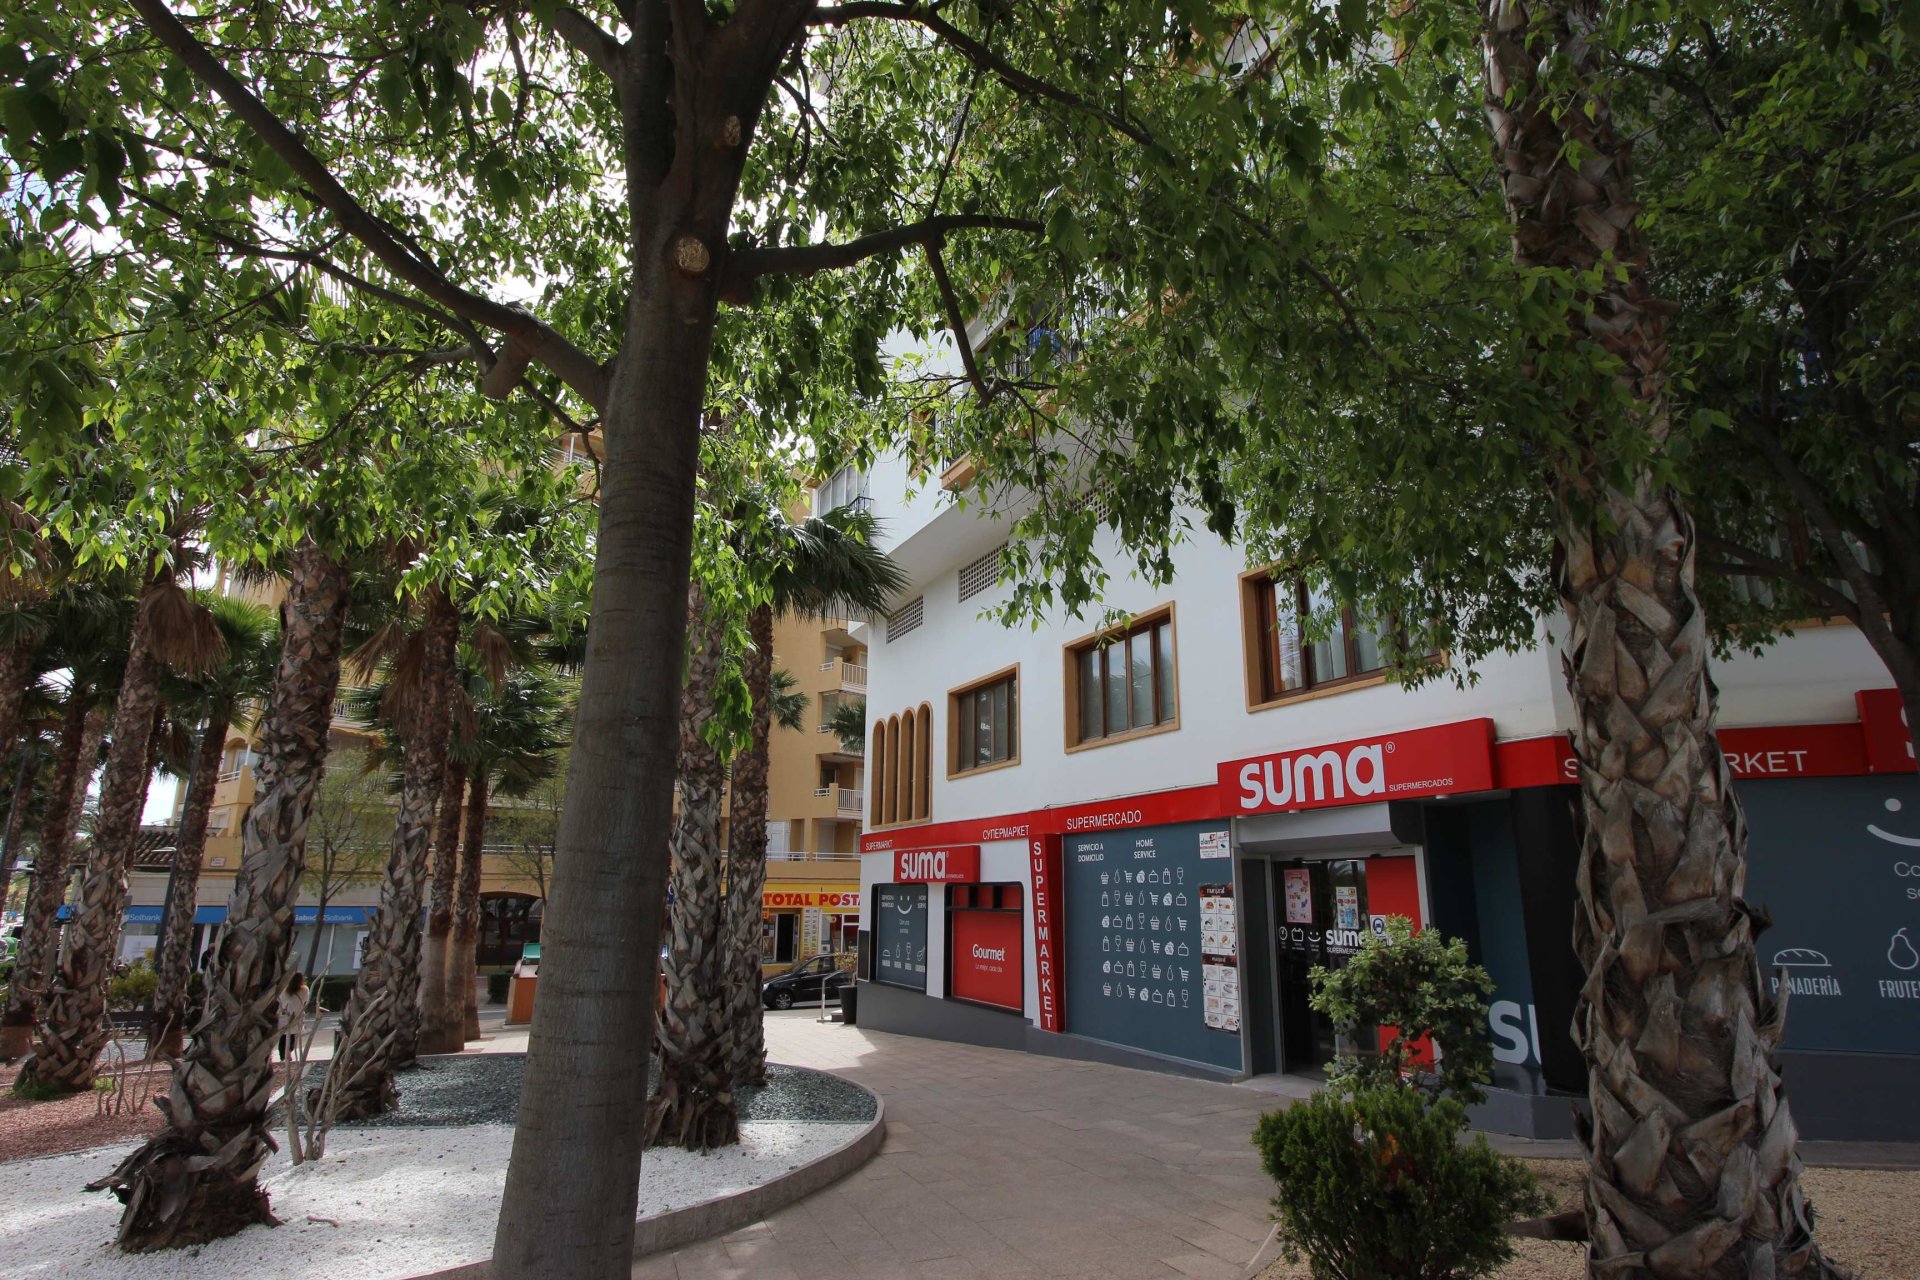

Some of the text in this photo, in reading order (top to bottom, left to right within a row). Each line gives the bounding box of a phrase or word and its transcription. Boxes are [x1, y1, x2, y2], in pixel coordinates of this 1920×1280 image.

[1240, 744, 1386, 809] suma
[1389, 777, 1453, 792] SUPERMERCADOS
[1067, 809, 1142, 830] SUPERMERCADO
[865, 840, 893, 851] SUPERMARKT
[1077, 842, 1104, 852] SERVICIO A
[1135, 838, 1154, 848] HOME
[1077, 853, 1104, 862] DOMICILIO
[1133, 849, 1156, 859] SERVICE
[901, 851, 946, 880] suma
[763, 893, 860, 906] TOTAL POST
[1033, 841, 1053, 1029] SUPERMARKET
[972, 943, 1005, 962] Gourmet
[1770, 975, 1842, 996] PNADERÍA
[1878, 979, 1920, 999] FRUTE
